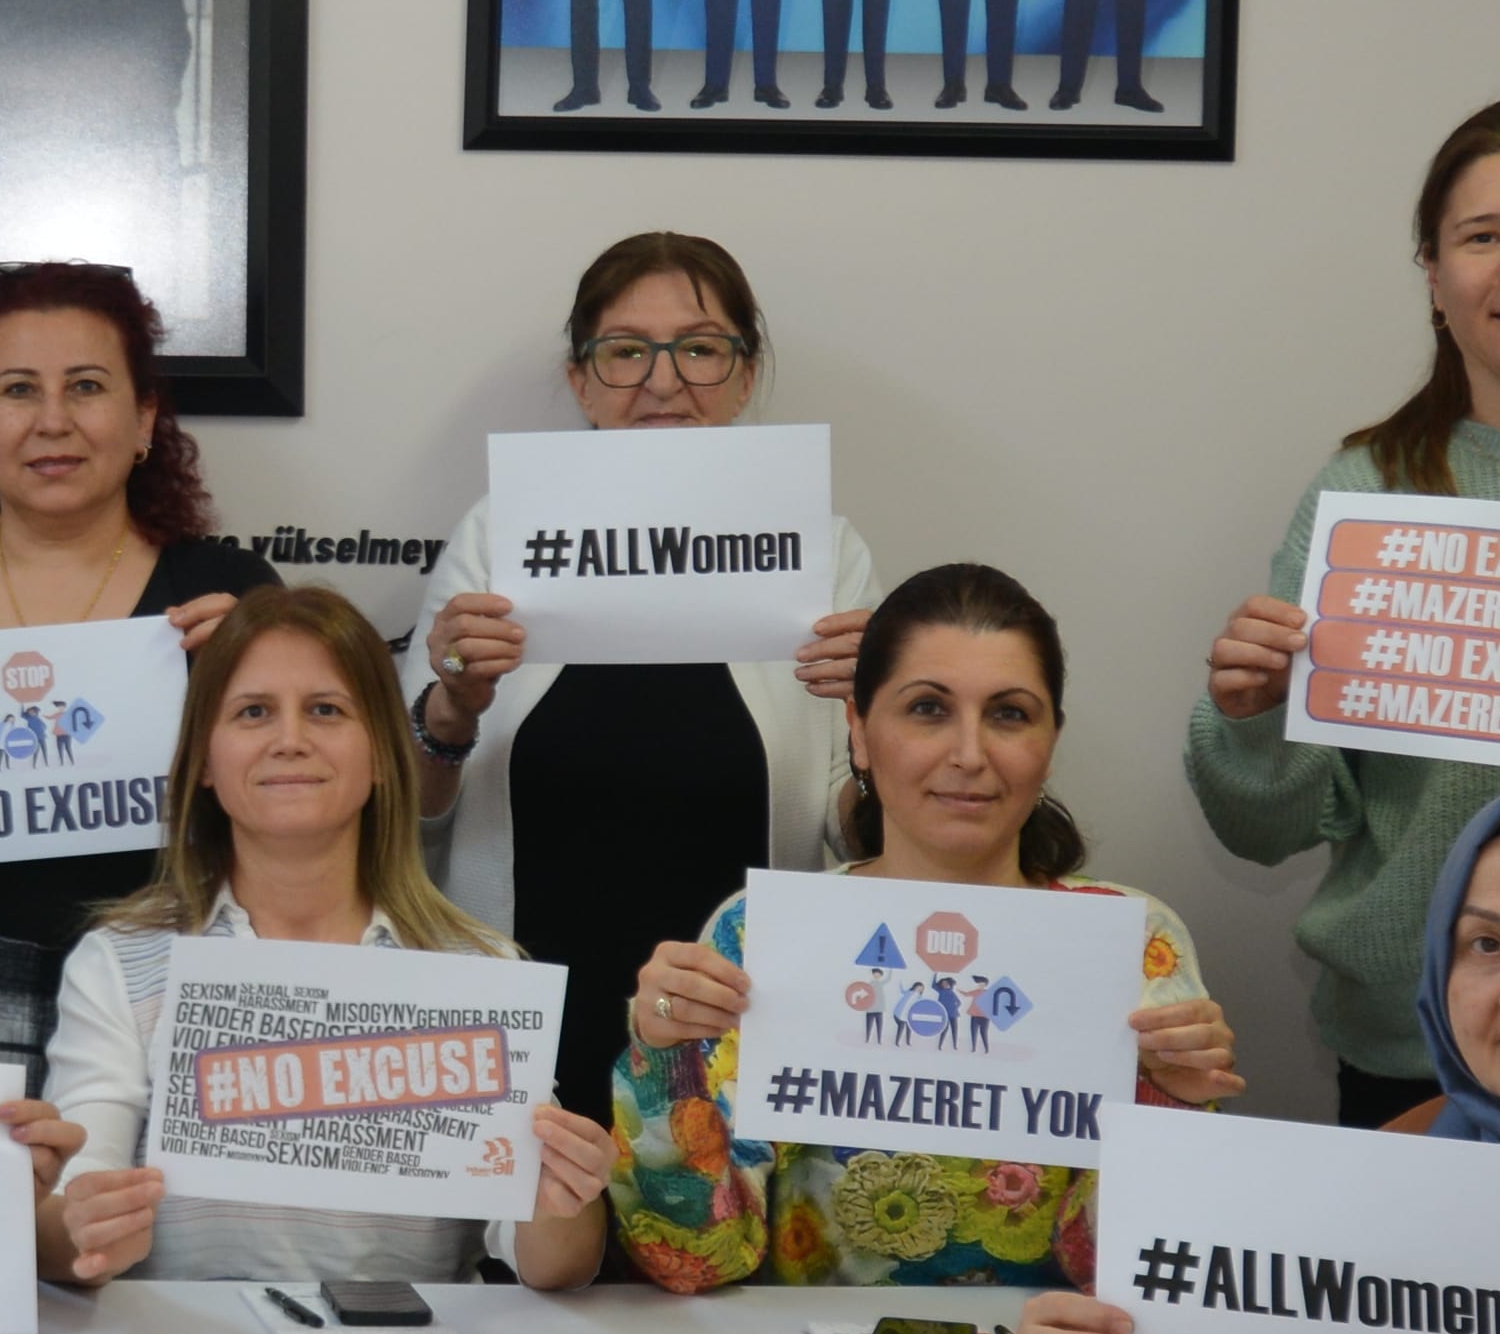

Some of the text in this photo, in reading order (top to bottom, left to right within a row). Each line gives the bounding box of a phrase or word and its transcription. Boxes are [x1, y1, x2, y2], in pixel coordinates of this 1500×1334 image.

[522, 526, 802, 578] #ALLWomen
[1376, 528, 1468, 575] #NO
[1360, 629, 1454, 677] #NO
[5, 662, 53, 691] STOP
[925, 929, 966, 957] DUR
[180, 982, 237, 1001] SEXISM
[237, 994, 319, 1015] HARASSMENT
[239, 982, 290, 999] SEXUAL
[175, 1001, 255, 1033] GENDER
[325, 1002, 418, 1024] MISOGYNY
[206, 1036, 500, 1113] #NO EXCUSE
[766, 1066, 1103, 1141] #MAZERET YOK
[162, 1118, 266, 1149] GENDER BASED
[302, 1117, 429, 1153] HARASSMENT
[265, 1140, 341, 1171] SEXISM
[342, 1145, 421, 1167] GENDER BASED
